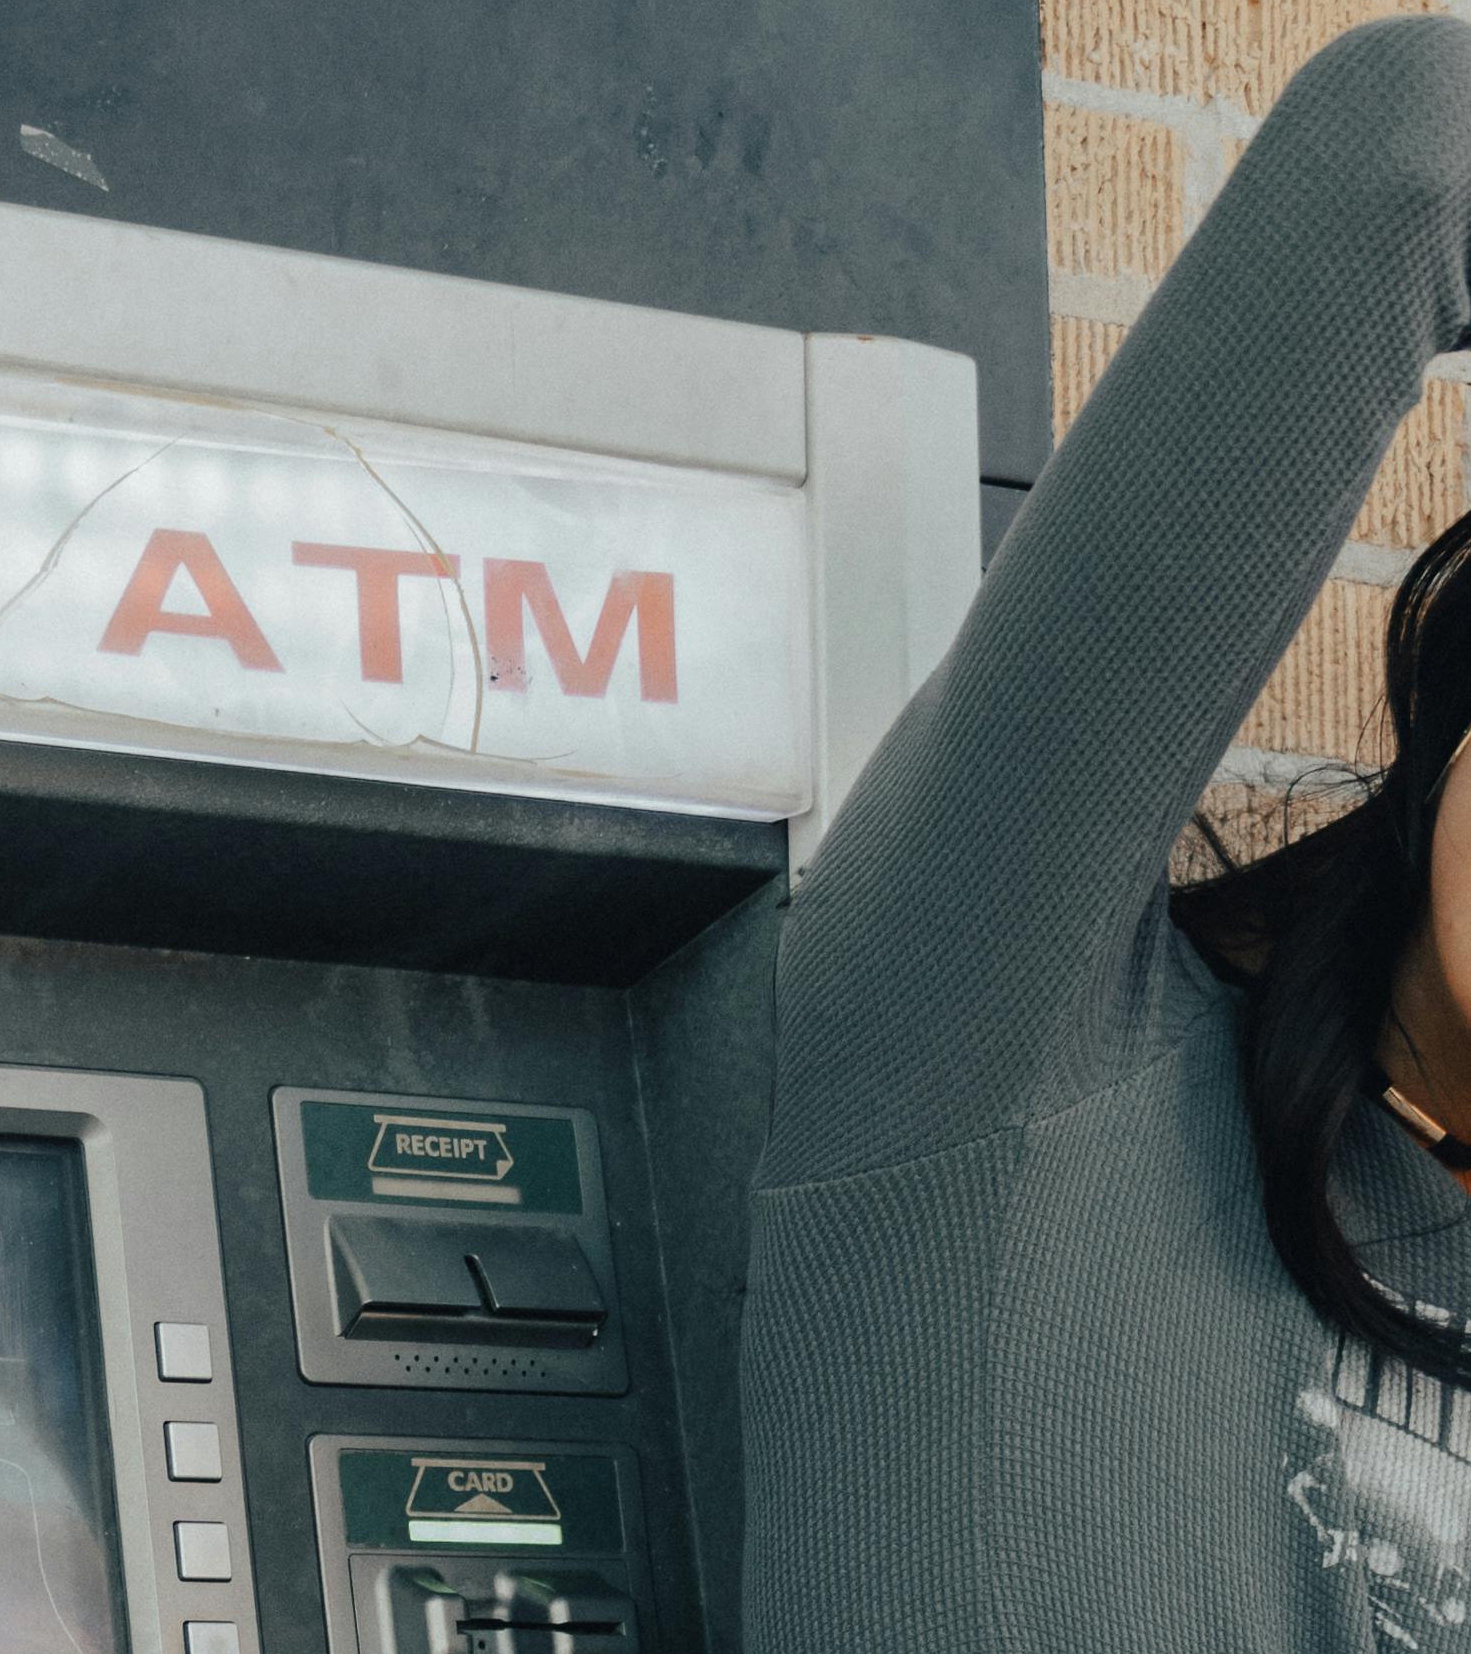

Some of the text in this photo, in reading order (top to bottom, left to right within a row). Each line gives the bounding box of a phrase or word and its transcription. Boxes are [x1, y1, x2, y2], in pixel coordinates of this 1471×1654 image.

[96, 527, 679, 705] ATM
[395, 1133, 487, 1161] RECEIPT
[447, 1471, 513, 1493] CARD
